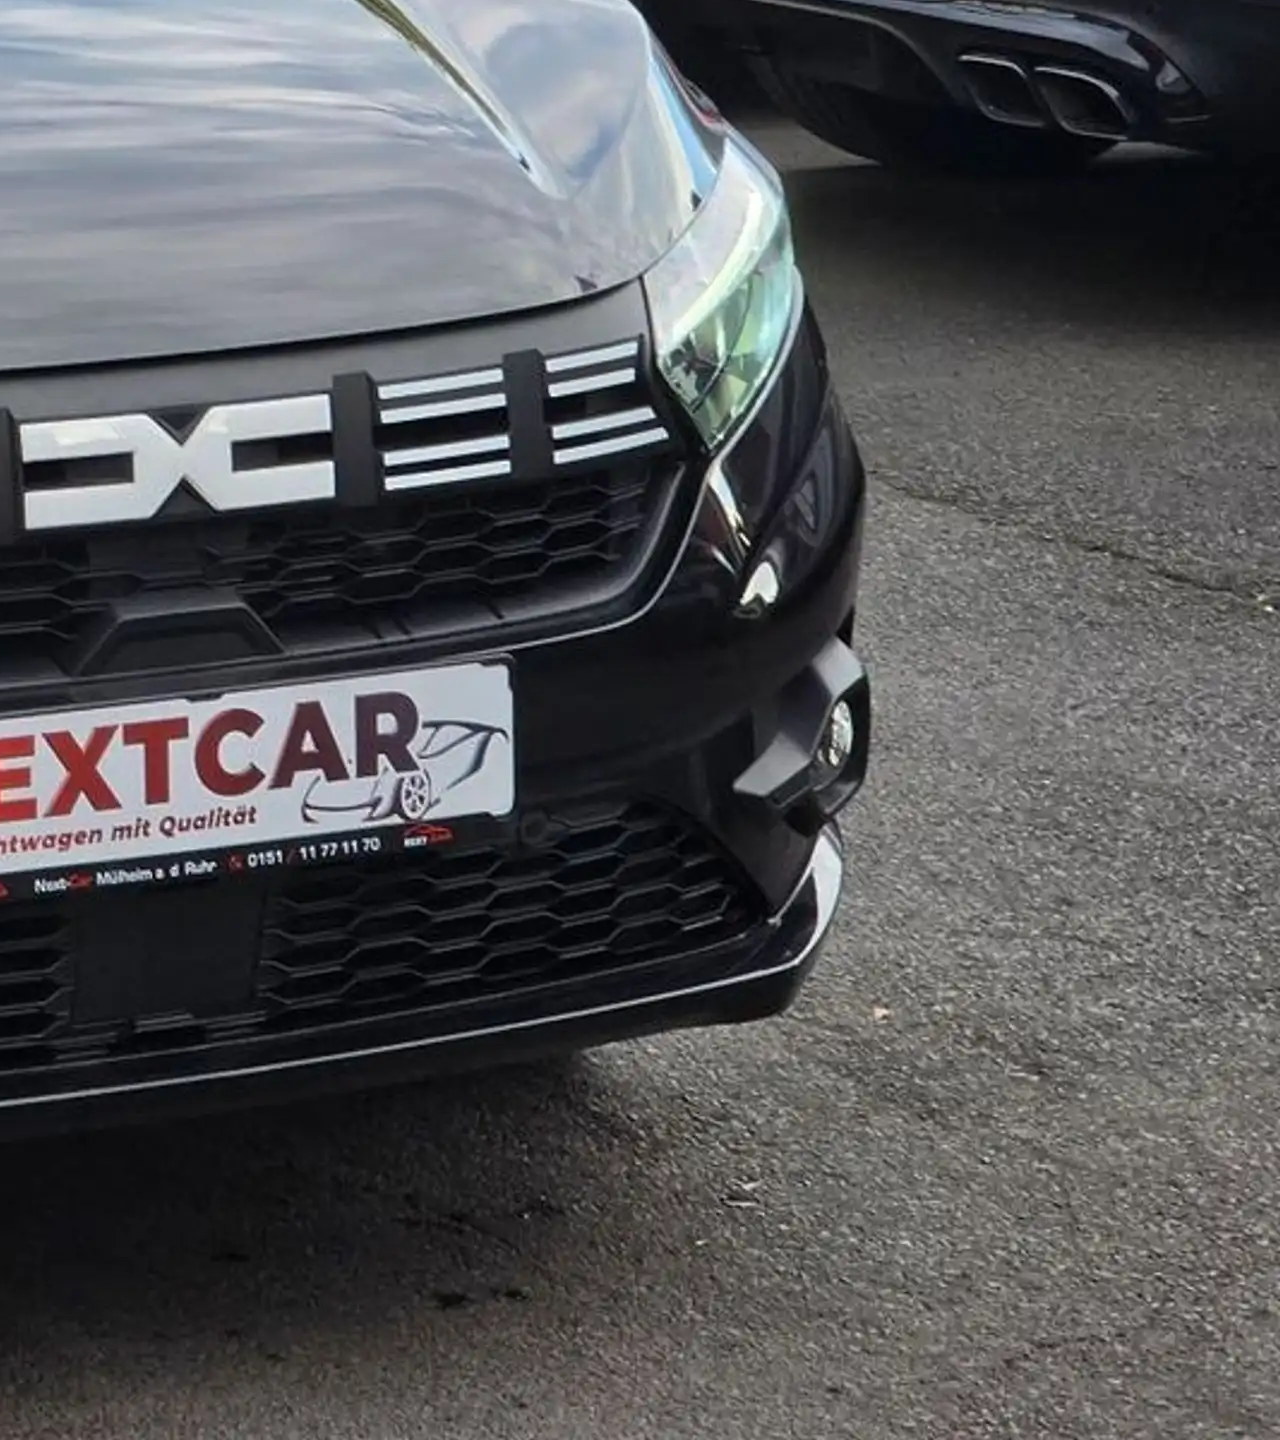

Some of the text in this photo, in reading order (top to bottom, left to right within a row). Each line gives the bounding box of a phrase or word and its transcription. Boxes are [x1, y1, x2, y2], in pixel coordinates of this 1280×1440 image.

[111, 815, 151, 841] mit
[158, 804, 257, 839] Qualität
[96, 867, 153, 887] Mülheim
[184, 859, 218, 876] Ruhr
[247, 850, 284, 868] 0151
[299, 846, 317, 861] 11
[320, 842, 338, 858] 77
[342, 839, 358, 855] 11
[361, 836, 382, 852] 70
